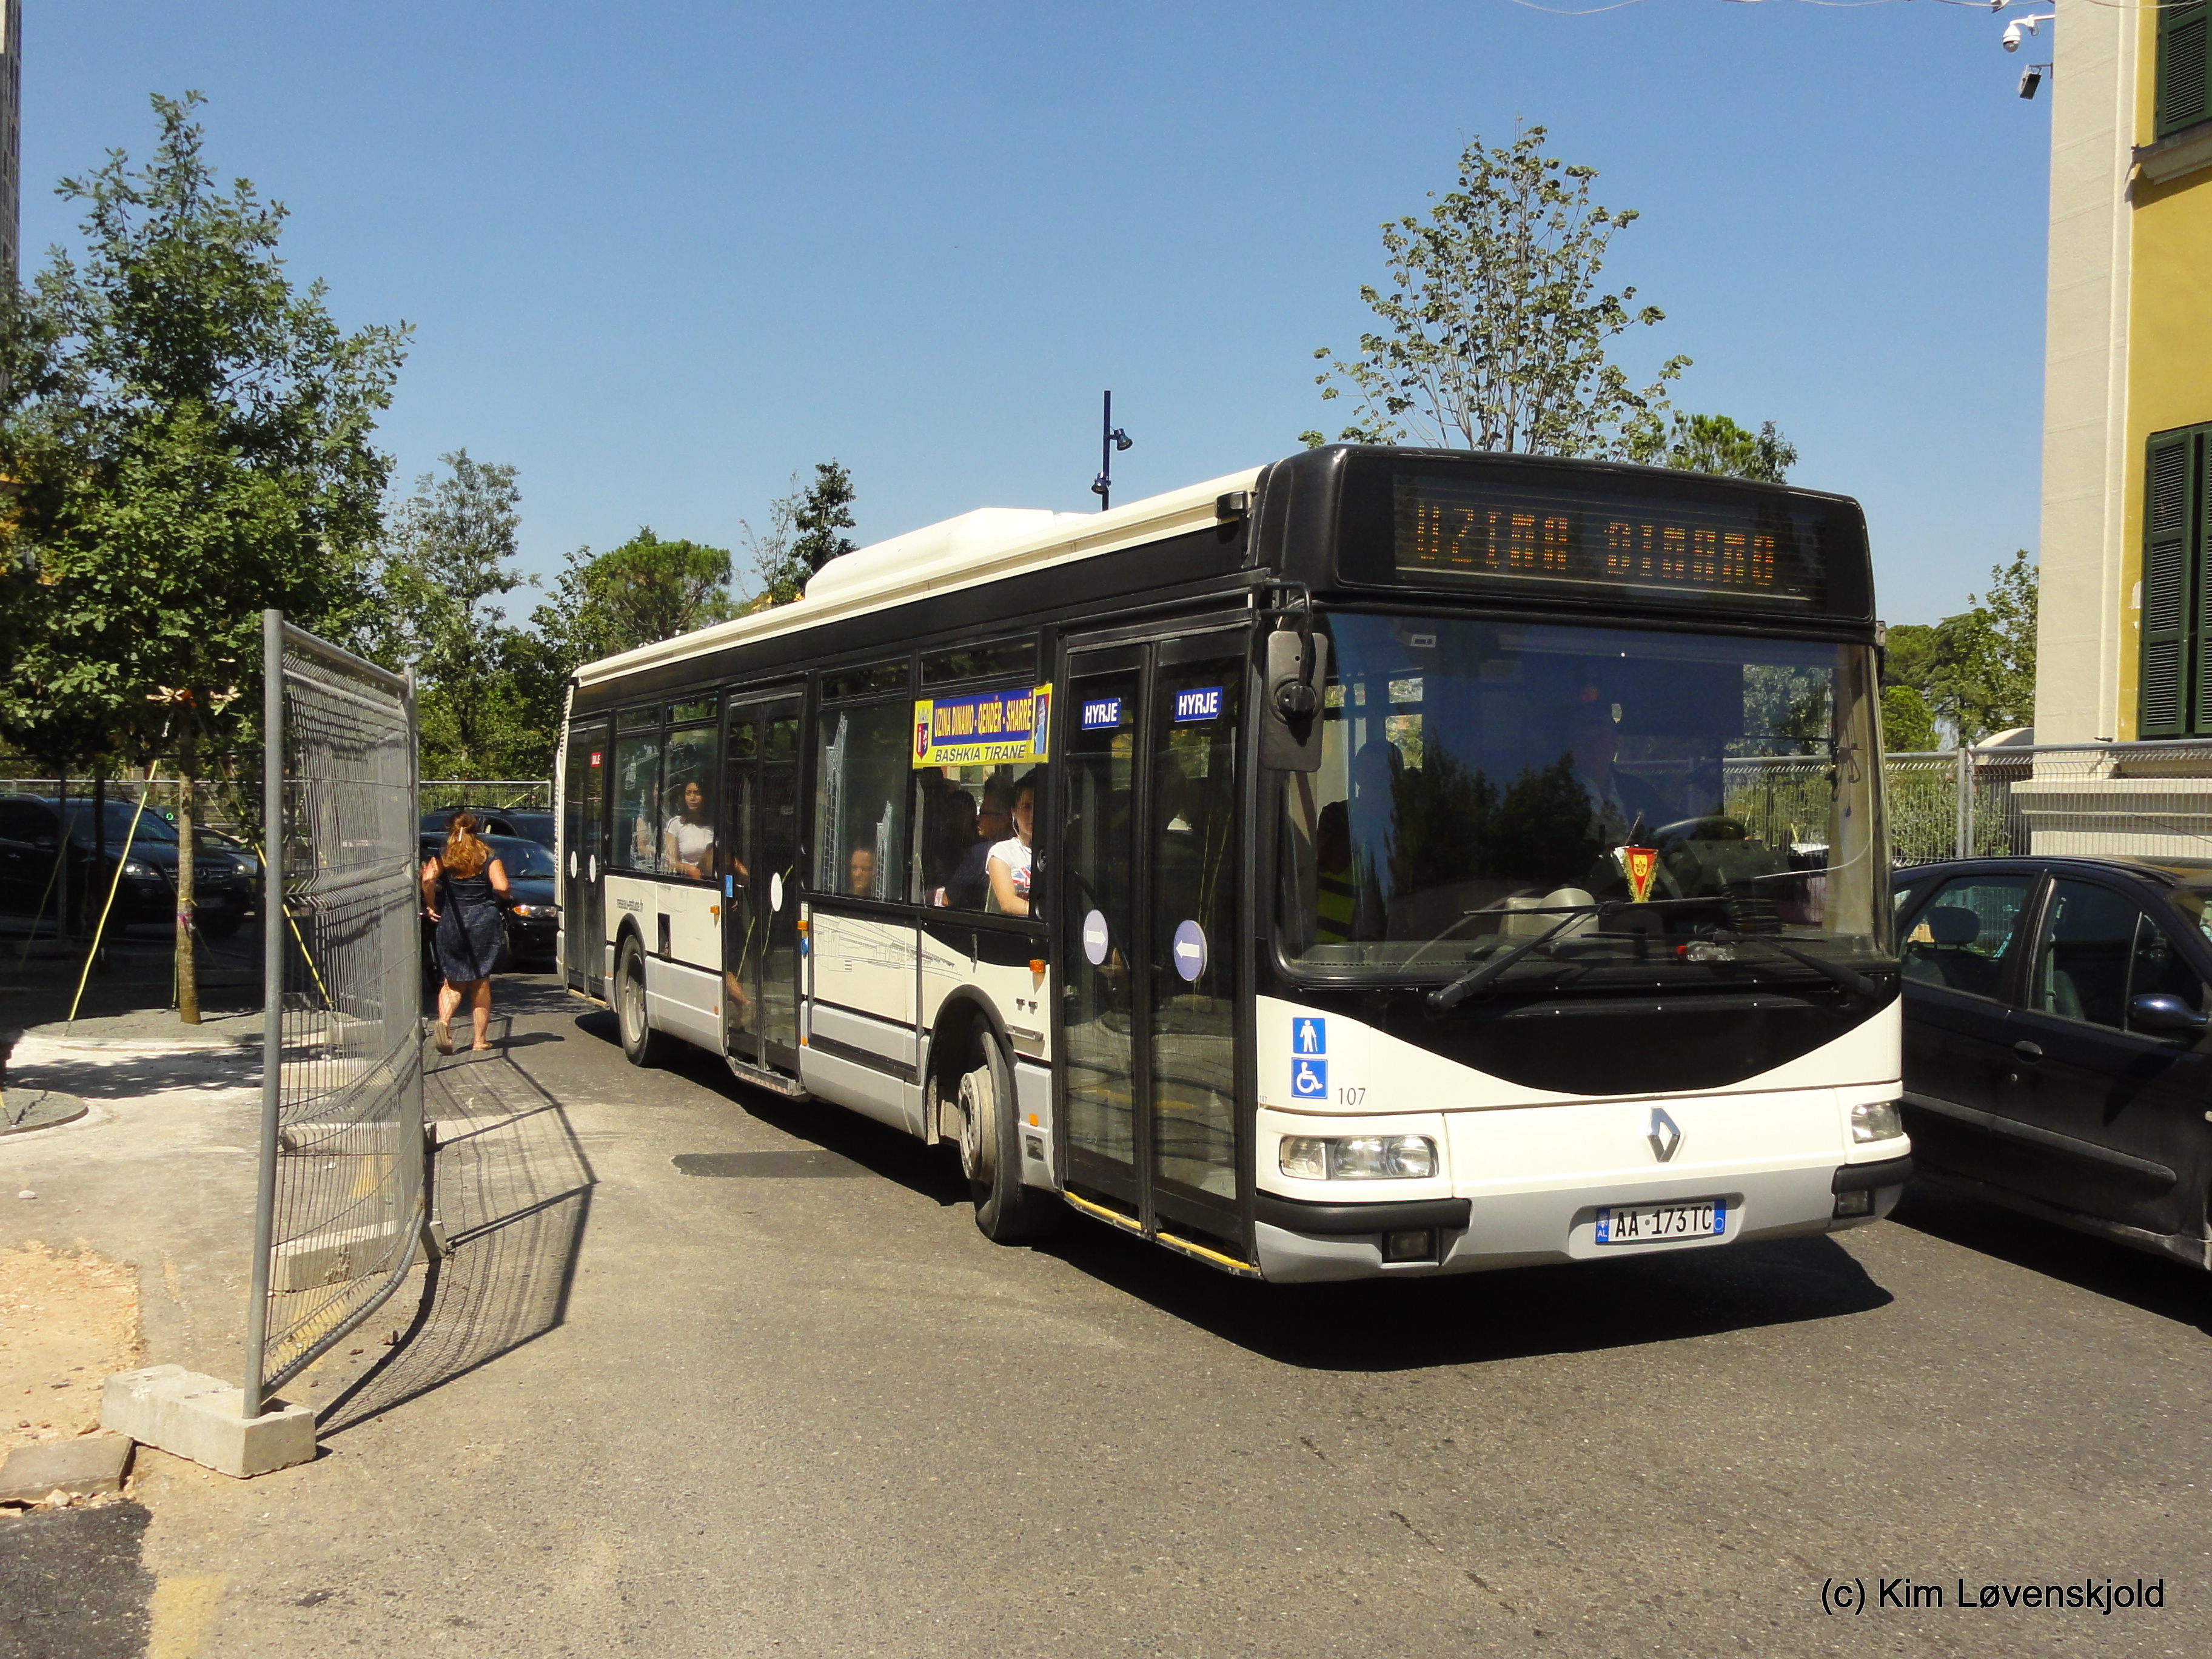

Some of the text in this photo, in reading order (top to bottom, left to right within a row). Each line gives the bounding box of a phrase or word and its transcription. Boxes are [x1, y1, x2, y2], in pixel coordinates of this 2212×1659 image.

[1084, 702, 1118, 724] HYRJE
[1178, 692, 1218, 716] HYRJE
[934, 706, 951, 737] UZINA
[951, 704, 974, 736] DINAMO
[934, 744, 1026, 762] BASHKIA TIRANE
[1338, 1088, 1366, 1105] 107
[1597, 1229, 1607, 1238] AL
[1615, 1211, 1639, 1238] AA
